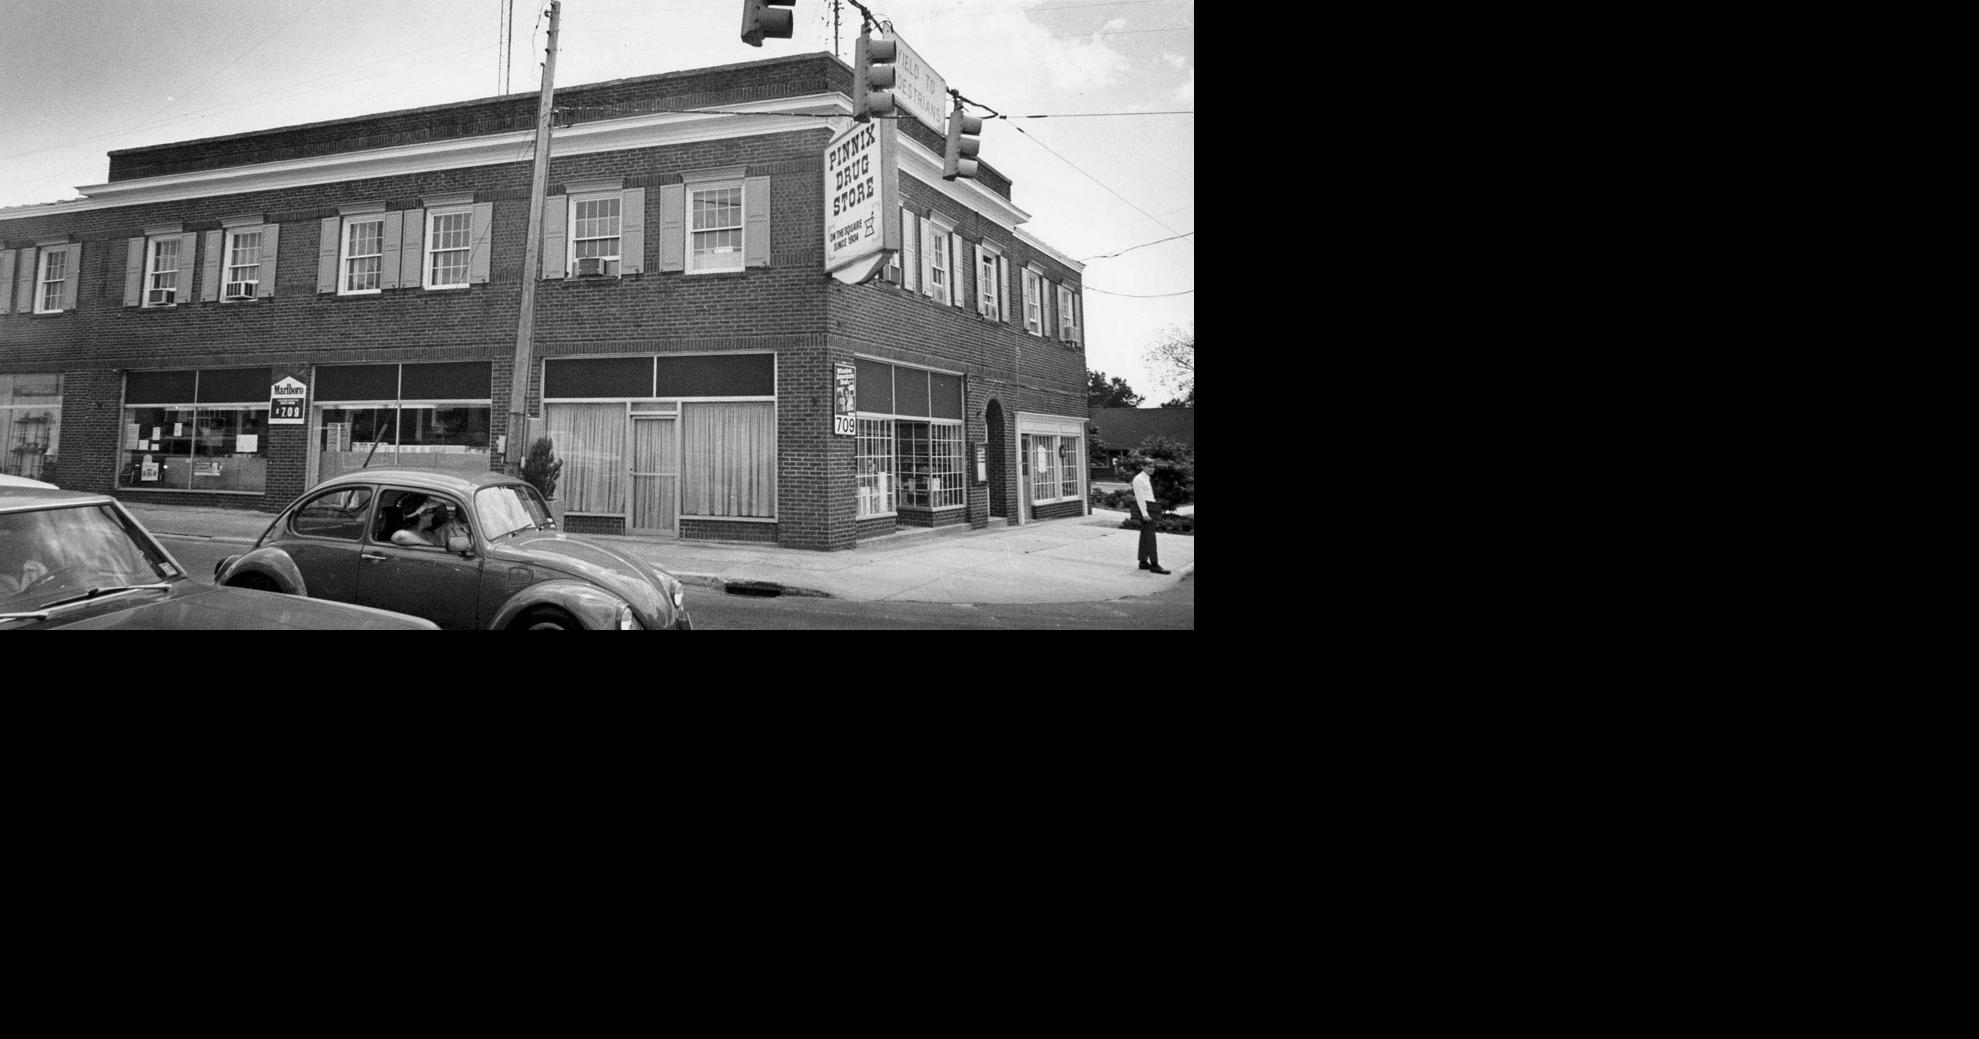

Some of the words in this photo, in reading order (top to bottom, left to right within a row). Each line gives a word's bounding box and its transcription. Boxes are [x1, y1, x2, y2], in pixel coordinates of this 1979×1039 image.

[898, 48, 919, 79] YIELD
[926, 74, 935, 95] TO
[897, 73, 941, 123] DESTRIANS
[830, 123, 875, 171] PINNIX
[836, 153, 869, 191] DRUG
[834, 176, 873, 216] STORE
[830, 233, 836, 242] ON
[836, 228, 844, 239] THE
[844, 219, 862, 235] SQUARE
[834, 238, 847, 251] SINCE
[274, 383, 304, 395] Marlboro
[836, 417, 854, 433] 709
